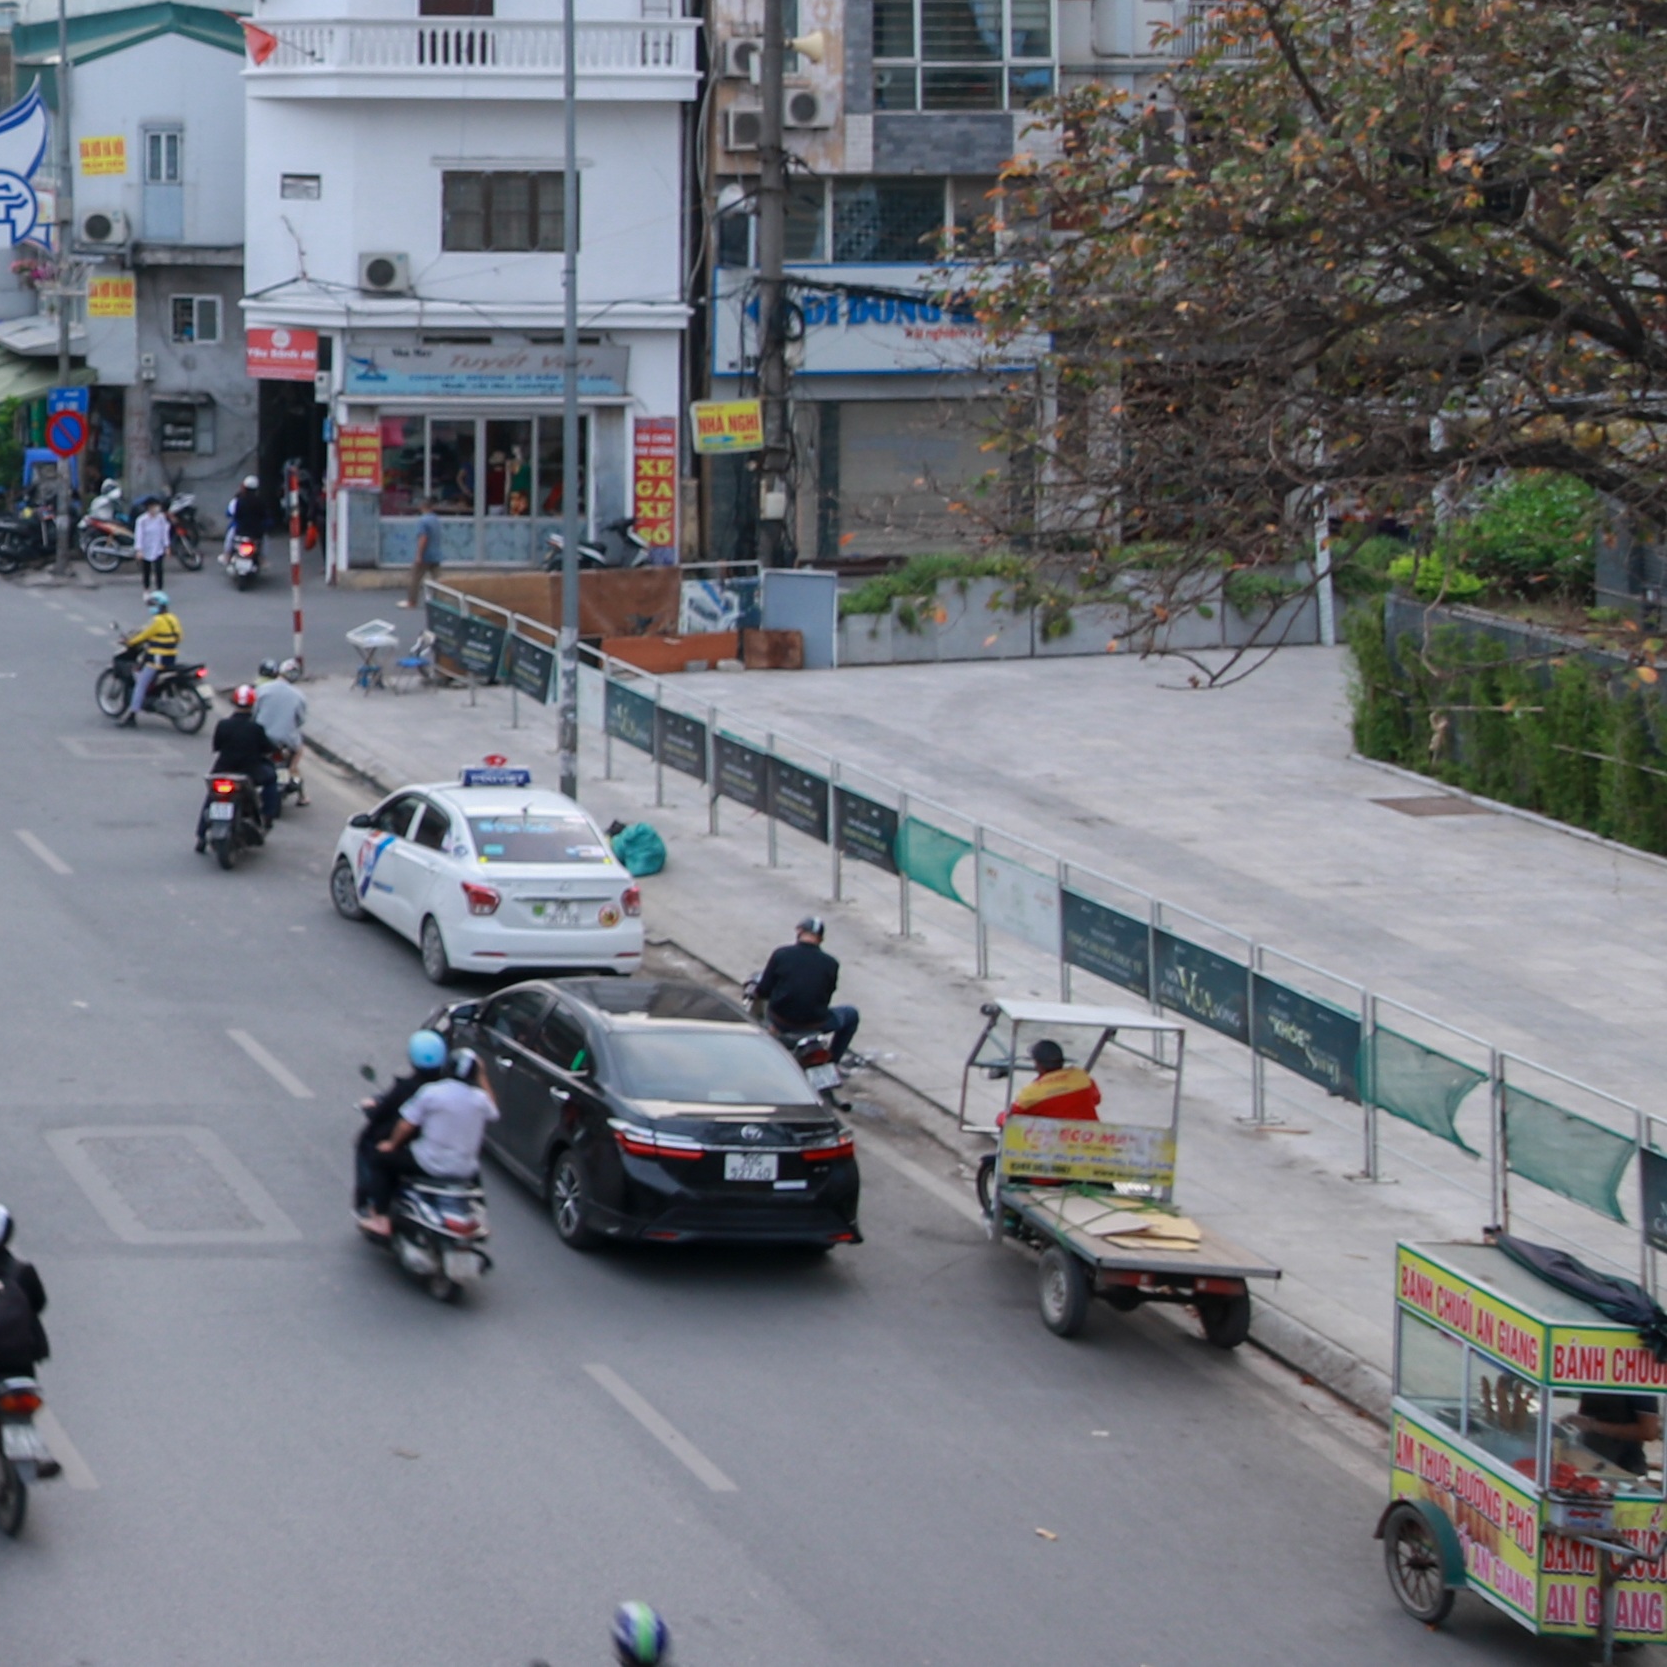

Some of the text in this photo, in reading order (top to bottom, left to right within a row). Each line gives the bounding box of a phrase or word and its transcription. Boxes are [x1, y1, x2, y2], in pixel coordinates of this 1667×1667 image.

[636, 480, 673, 498] GA
[637, 458, 673, 477] XE
[637, 501, 672, 519] XE
[637, 521, 671, 546] SỐ
[1401, 1263, 1539, 1372] BÁNH CHUỐI AN GIANG
[1553, 1337, 1606, 1381] BÁNH
[1417, 1442, 1453, 1494] THỰC
[1505, 1502, 1536, 1559] PHỐ
[1474, 1540, 1492, 1582] AN
[1494, 1554, 1535, 1612] GIANG
[1544, 1583, 1665, 1633] AN GANG
